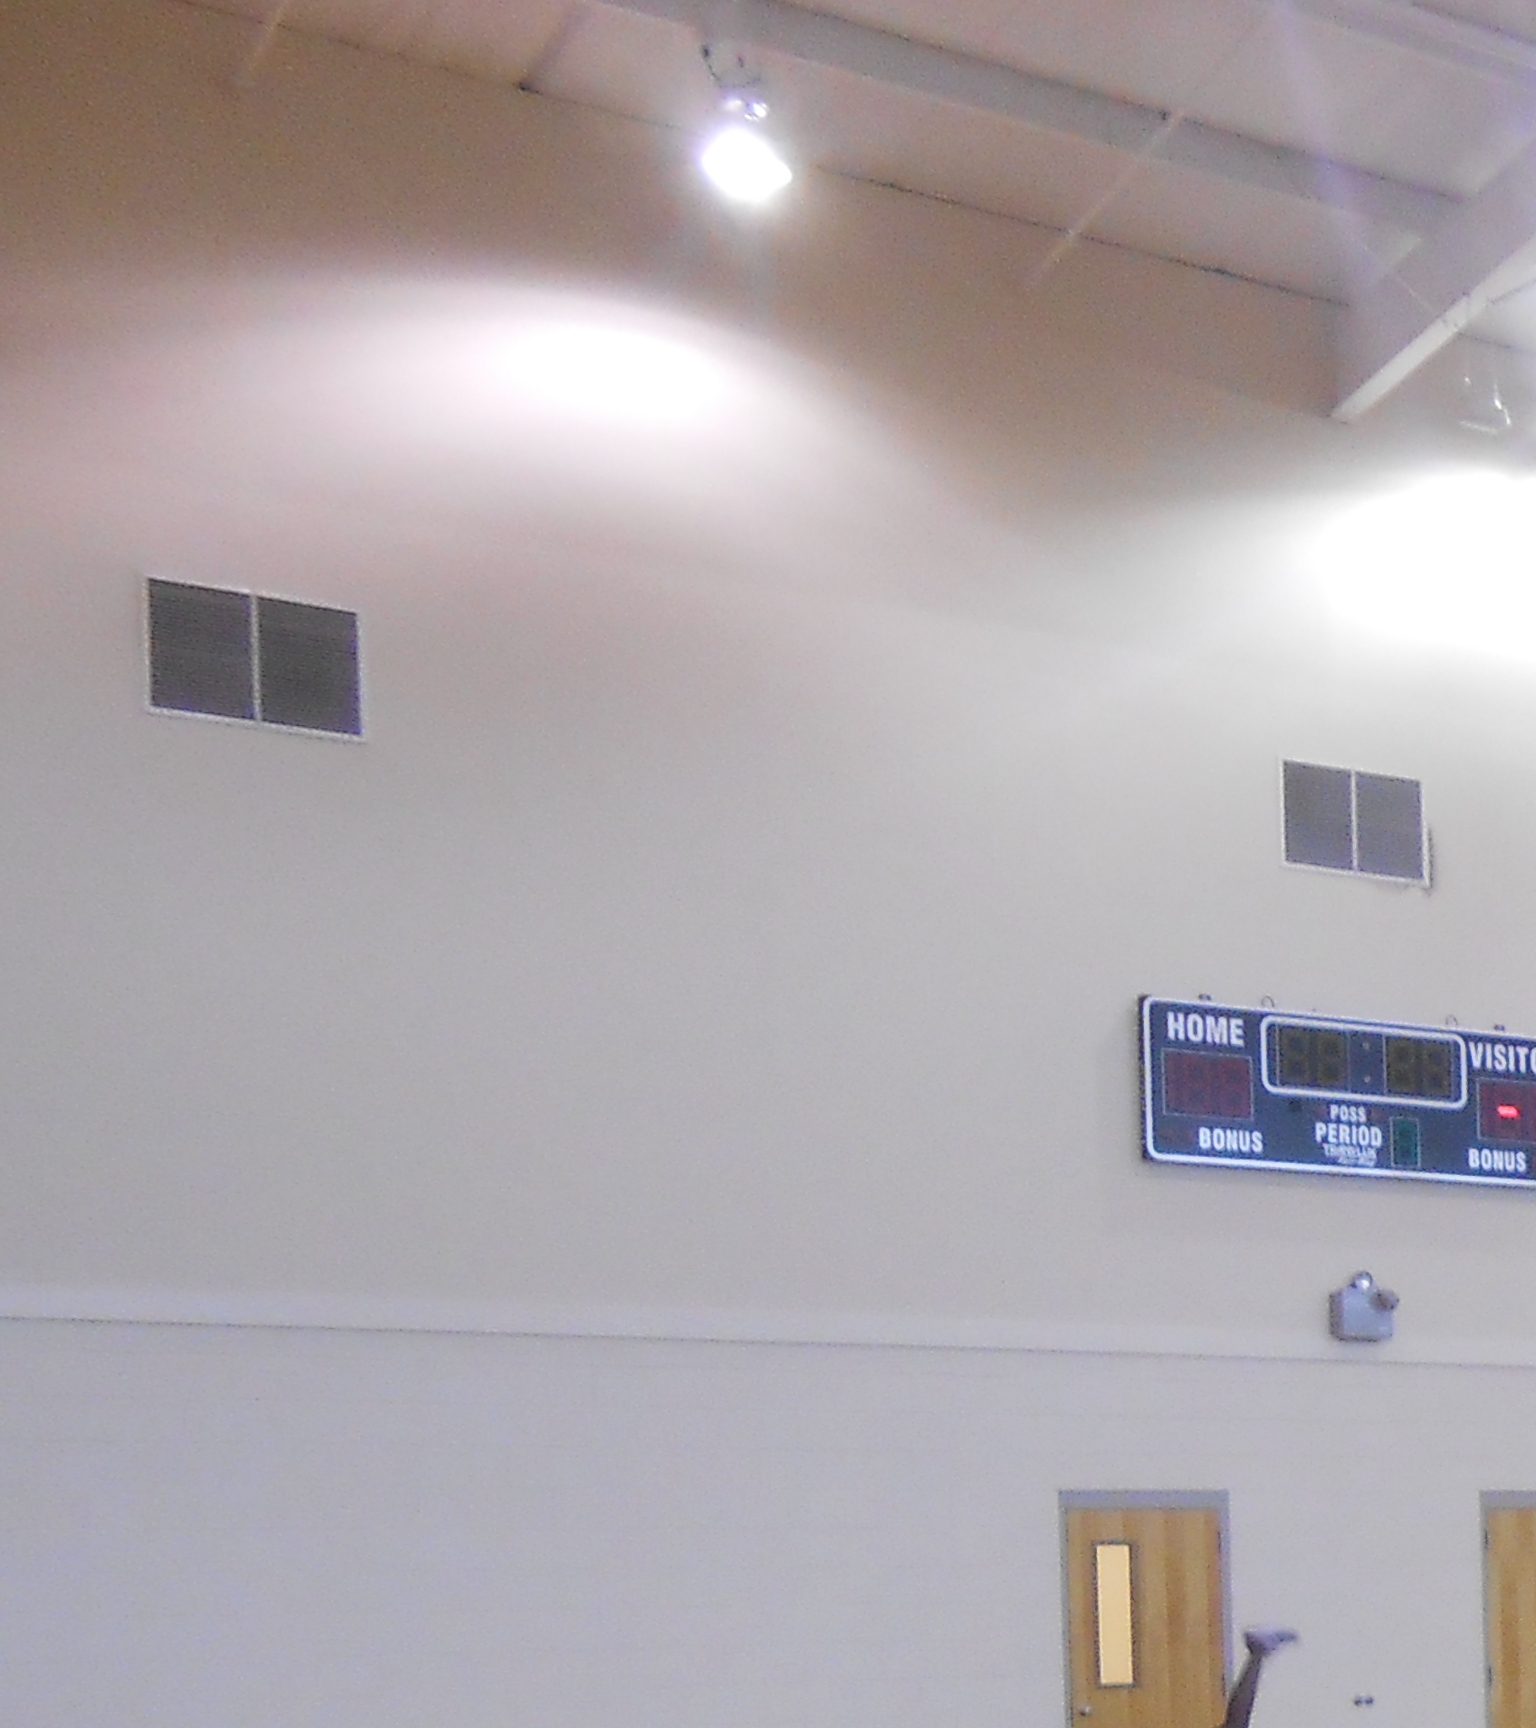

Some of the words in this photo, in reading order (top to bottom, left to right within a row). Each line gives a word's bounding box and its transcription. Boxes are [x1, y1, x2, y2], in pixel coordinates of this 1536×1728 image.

[1166, 1011, 1245, 1047] HOME
[1329, 1104, 1367, 1123] POSS
[1198, 1127, 1264, 1153] BONUS
[1315, 1122, 1382, 1148] PERIOD
[1468, 1148, 1527, 1172] BONUS
